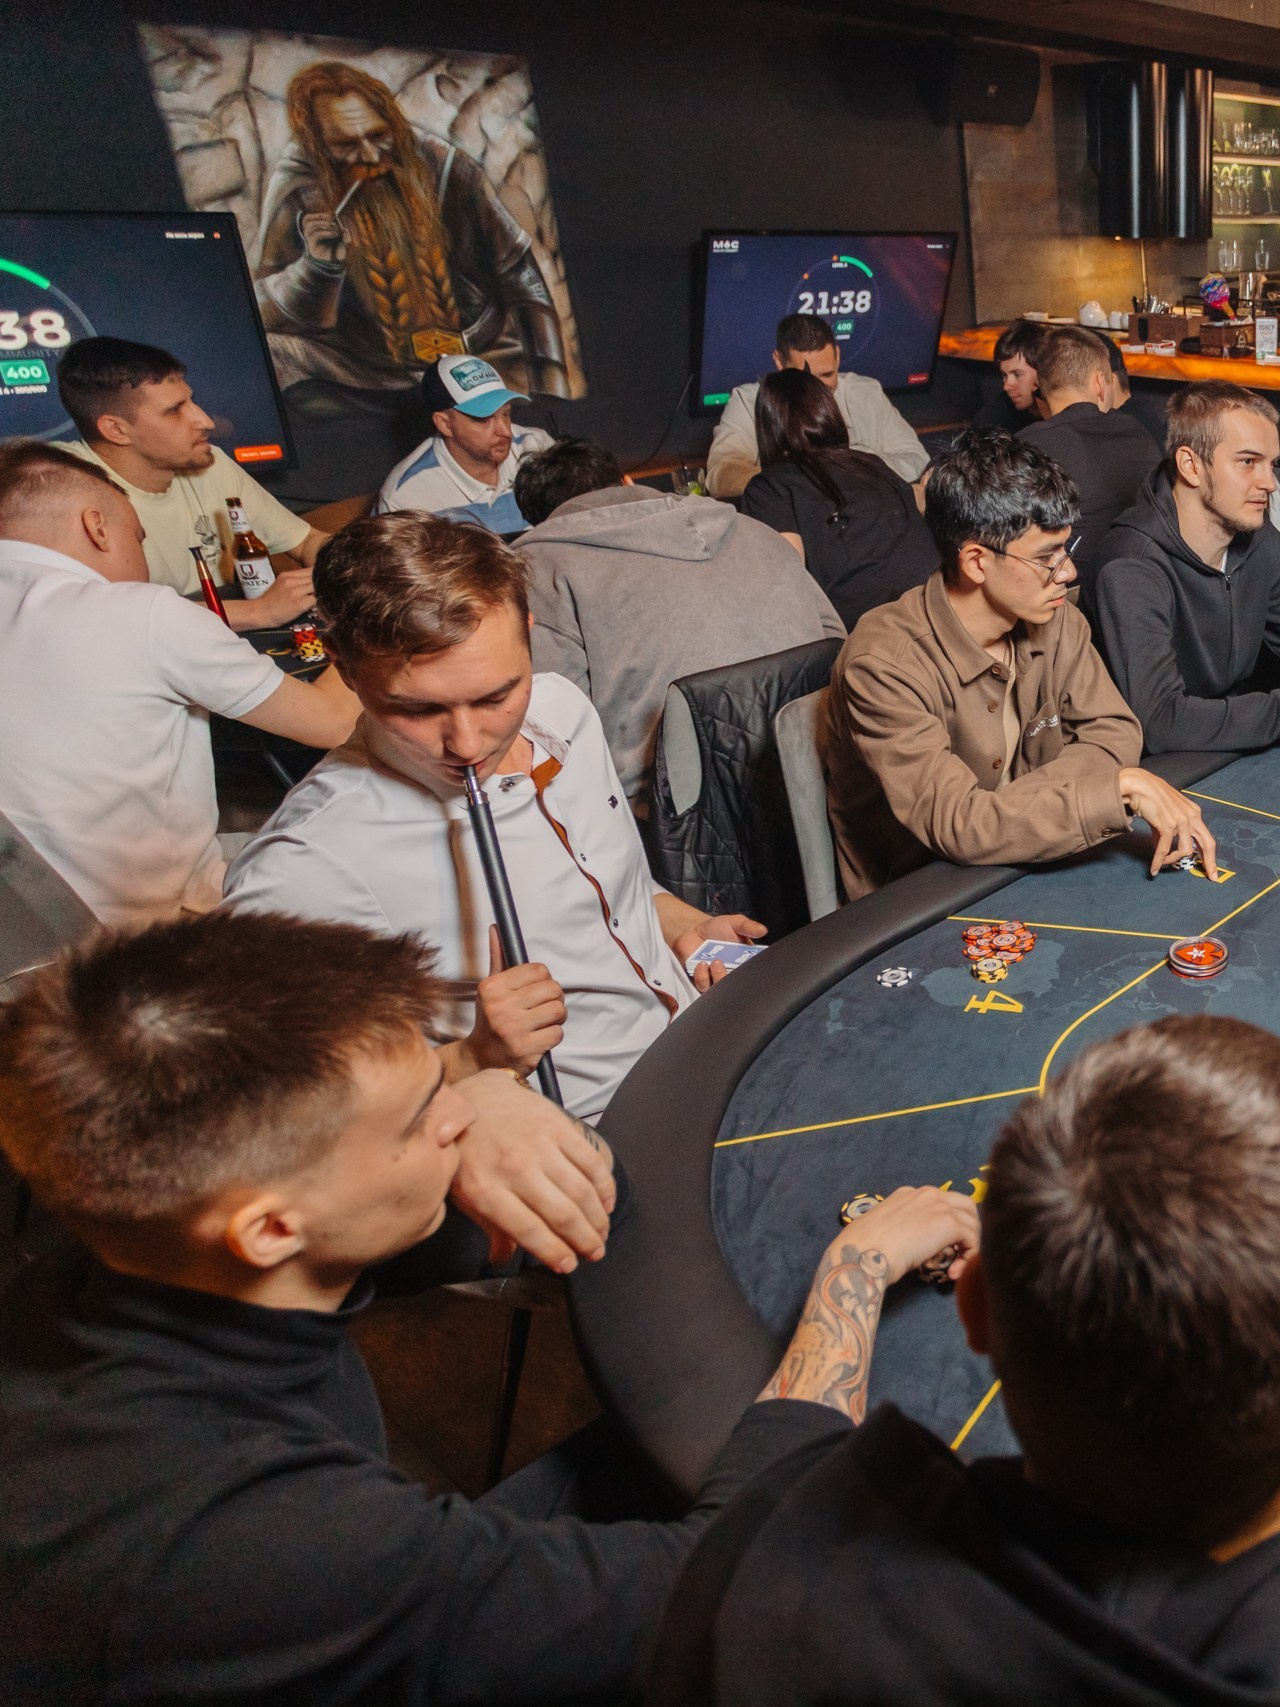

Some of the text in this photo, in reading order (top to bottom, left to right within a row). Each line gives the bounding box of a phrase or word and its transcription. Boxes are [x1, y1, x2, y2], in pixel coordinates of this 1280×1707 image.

[797, 290, 872, 315] 21:38
[836, 322, 853, 332] 400
[7, 365, 43, 380] 400
[963, 990, 1025, 1014] 4
